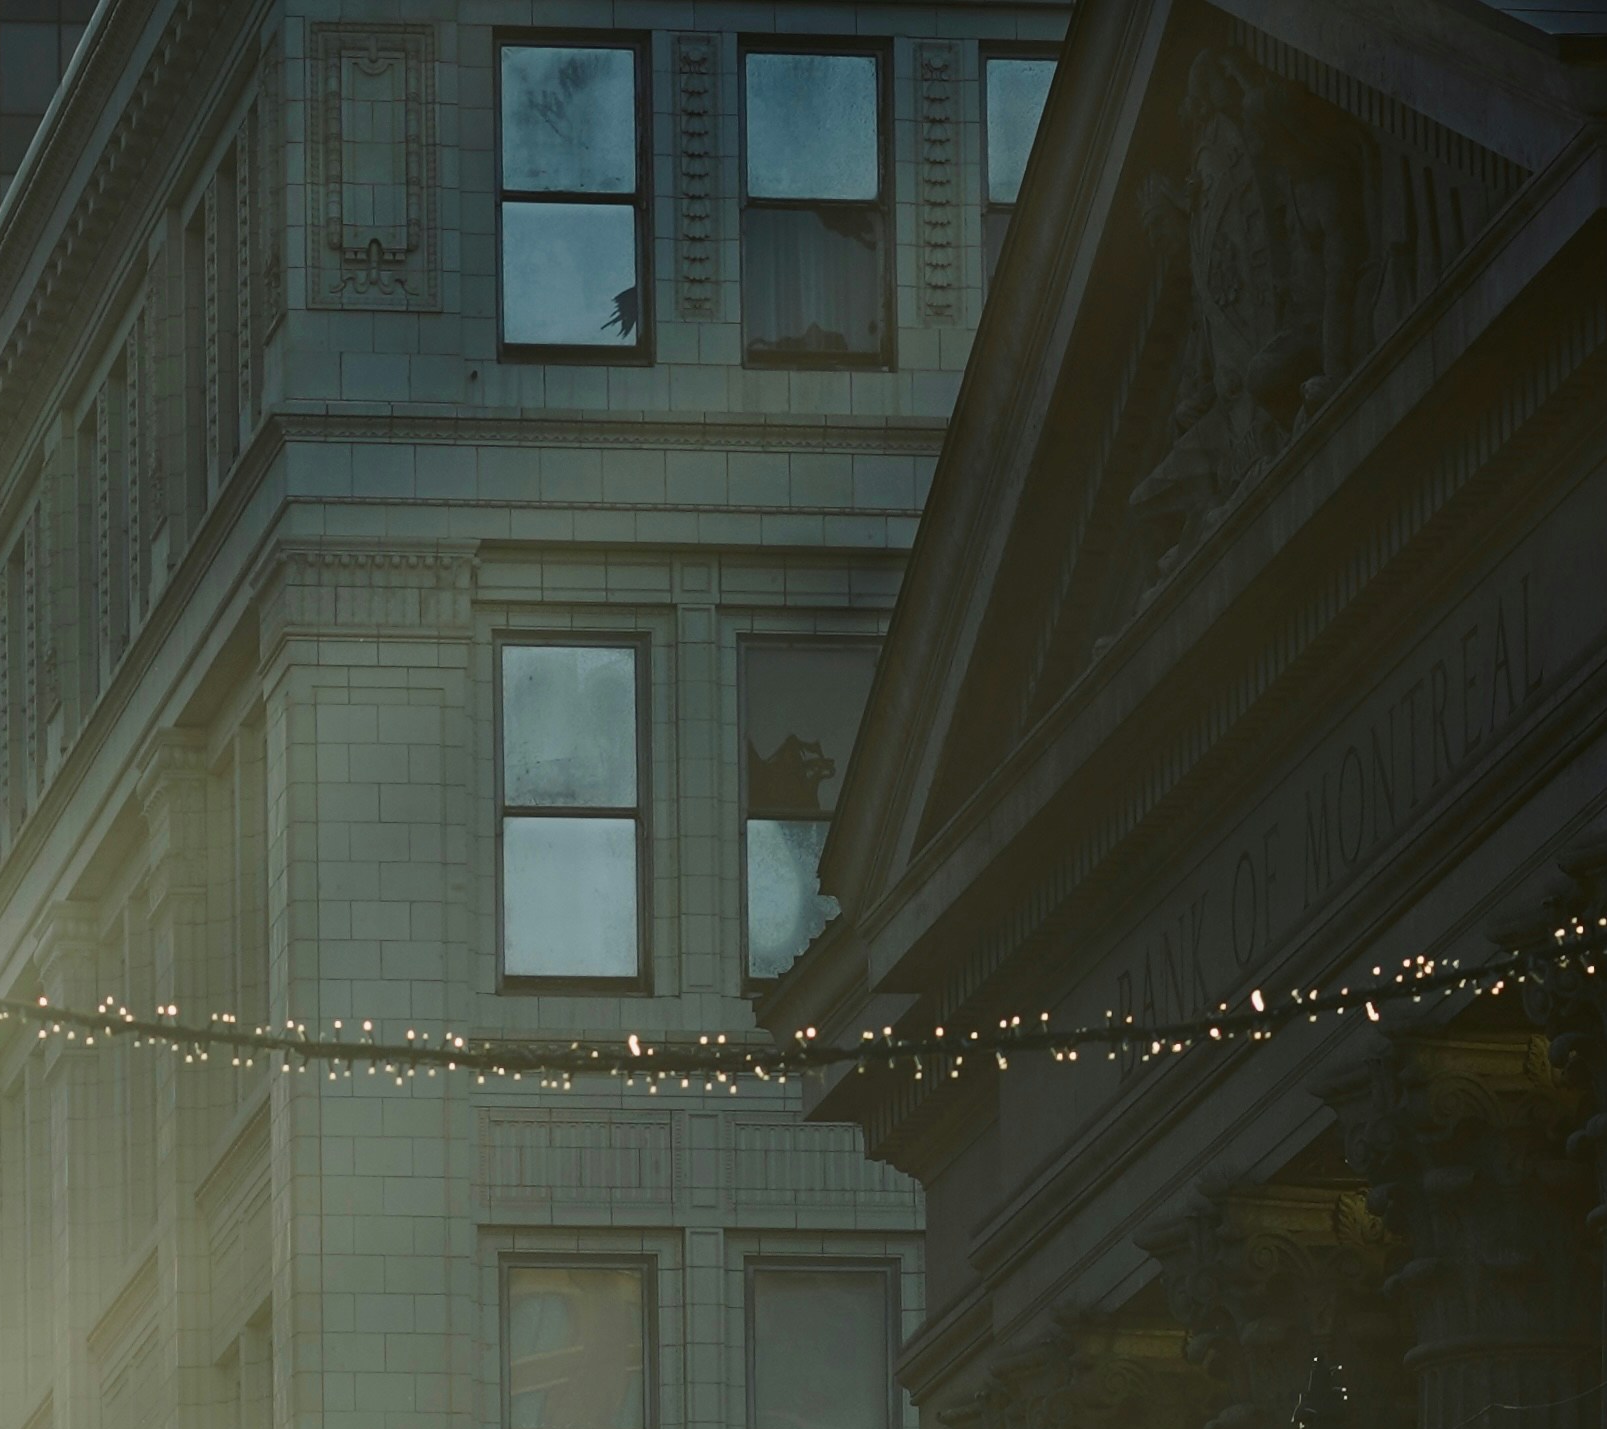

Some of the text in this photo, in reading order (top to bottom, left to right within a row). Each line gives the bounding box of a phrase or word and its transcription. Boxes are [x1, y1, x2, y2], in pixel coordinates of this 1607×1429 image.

[1117, 572, 1545, 1083] BANK OF MONTREAL
